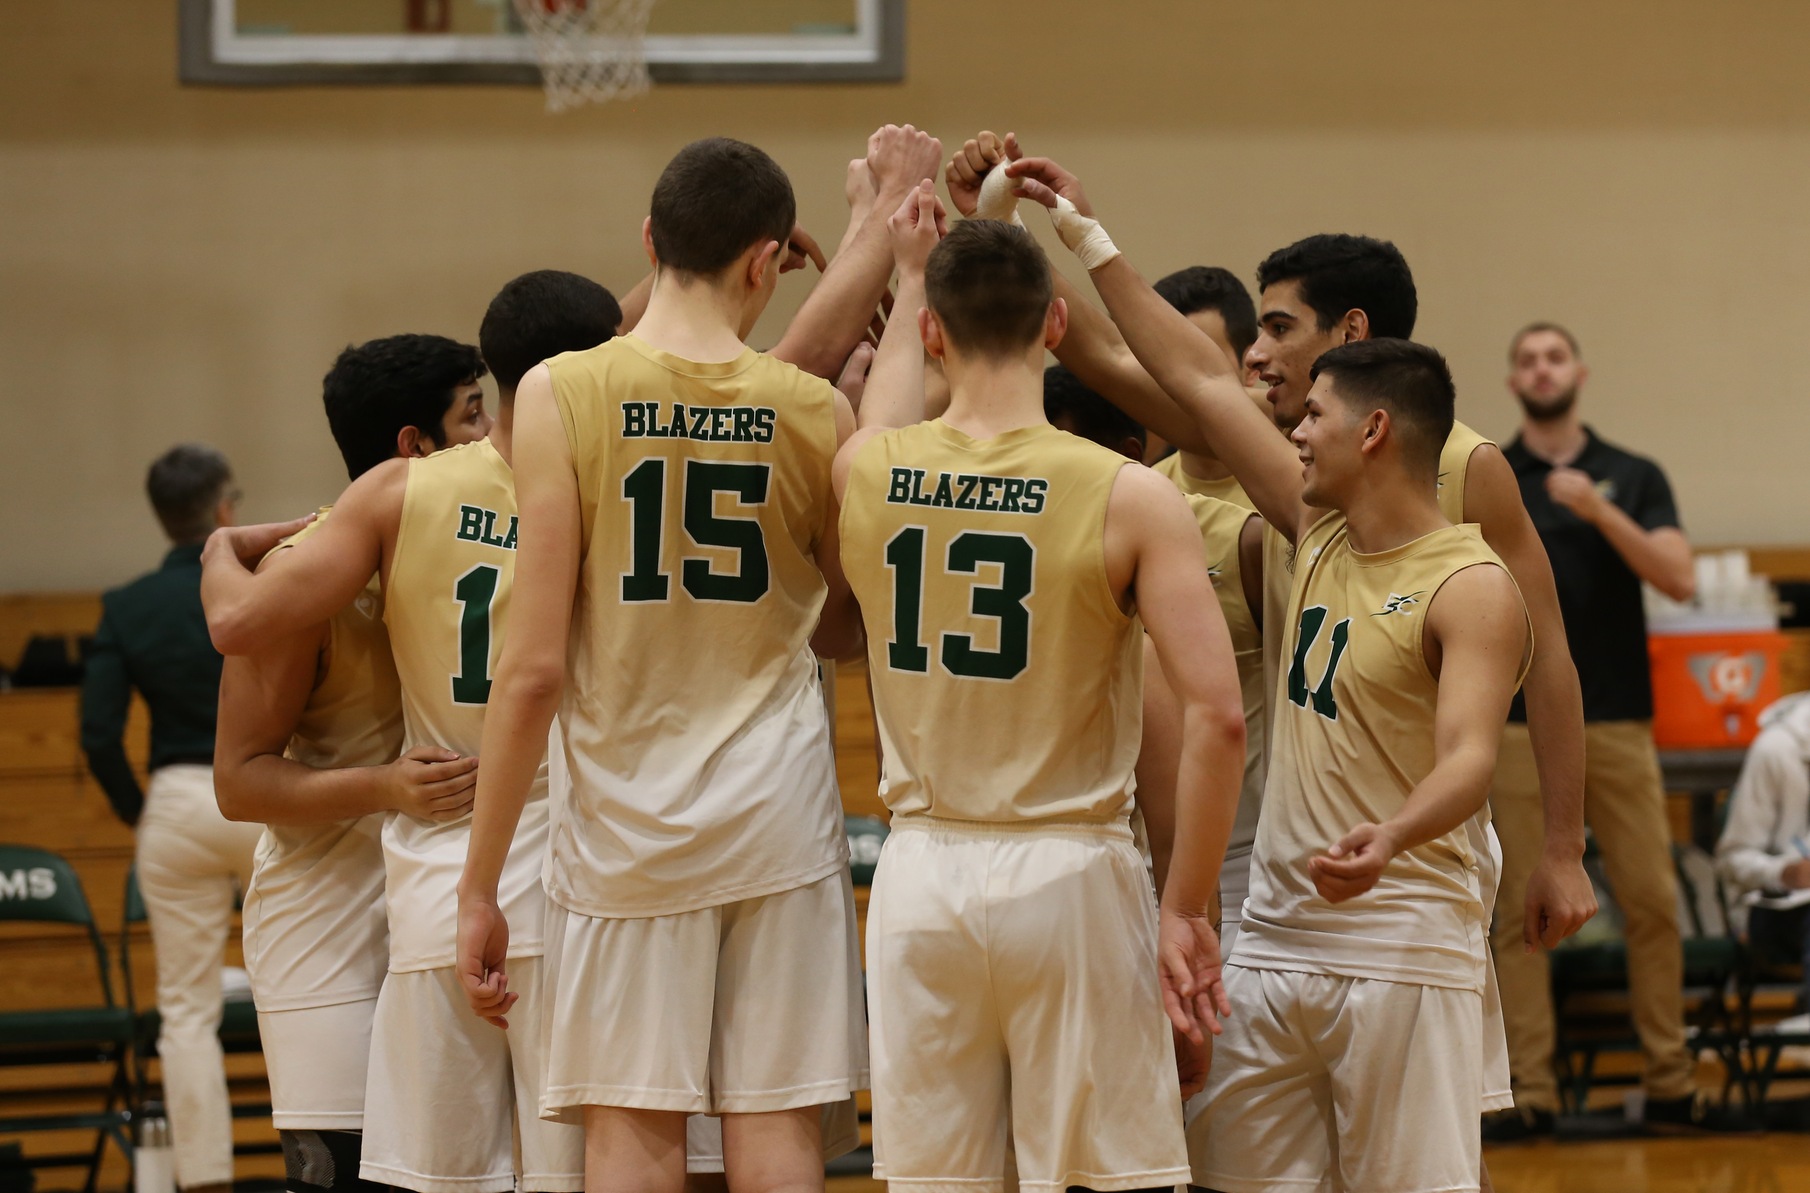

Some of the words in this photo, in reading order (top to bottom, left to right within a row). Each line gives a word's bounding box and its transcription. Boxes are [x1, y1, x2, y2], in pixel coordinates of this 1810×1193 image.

[621, 401, 776, 443] BLAZERS
[619, 456, 773, 605] 15
[886, 466, 1048, 515] BLAZERS
[884, 523, 1037, 683] 13
[1287, 604, 1353, 723] 11
